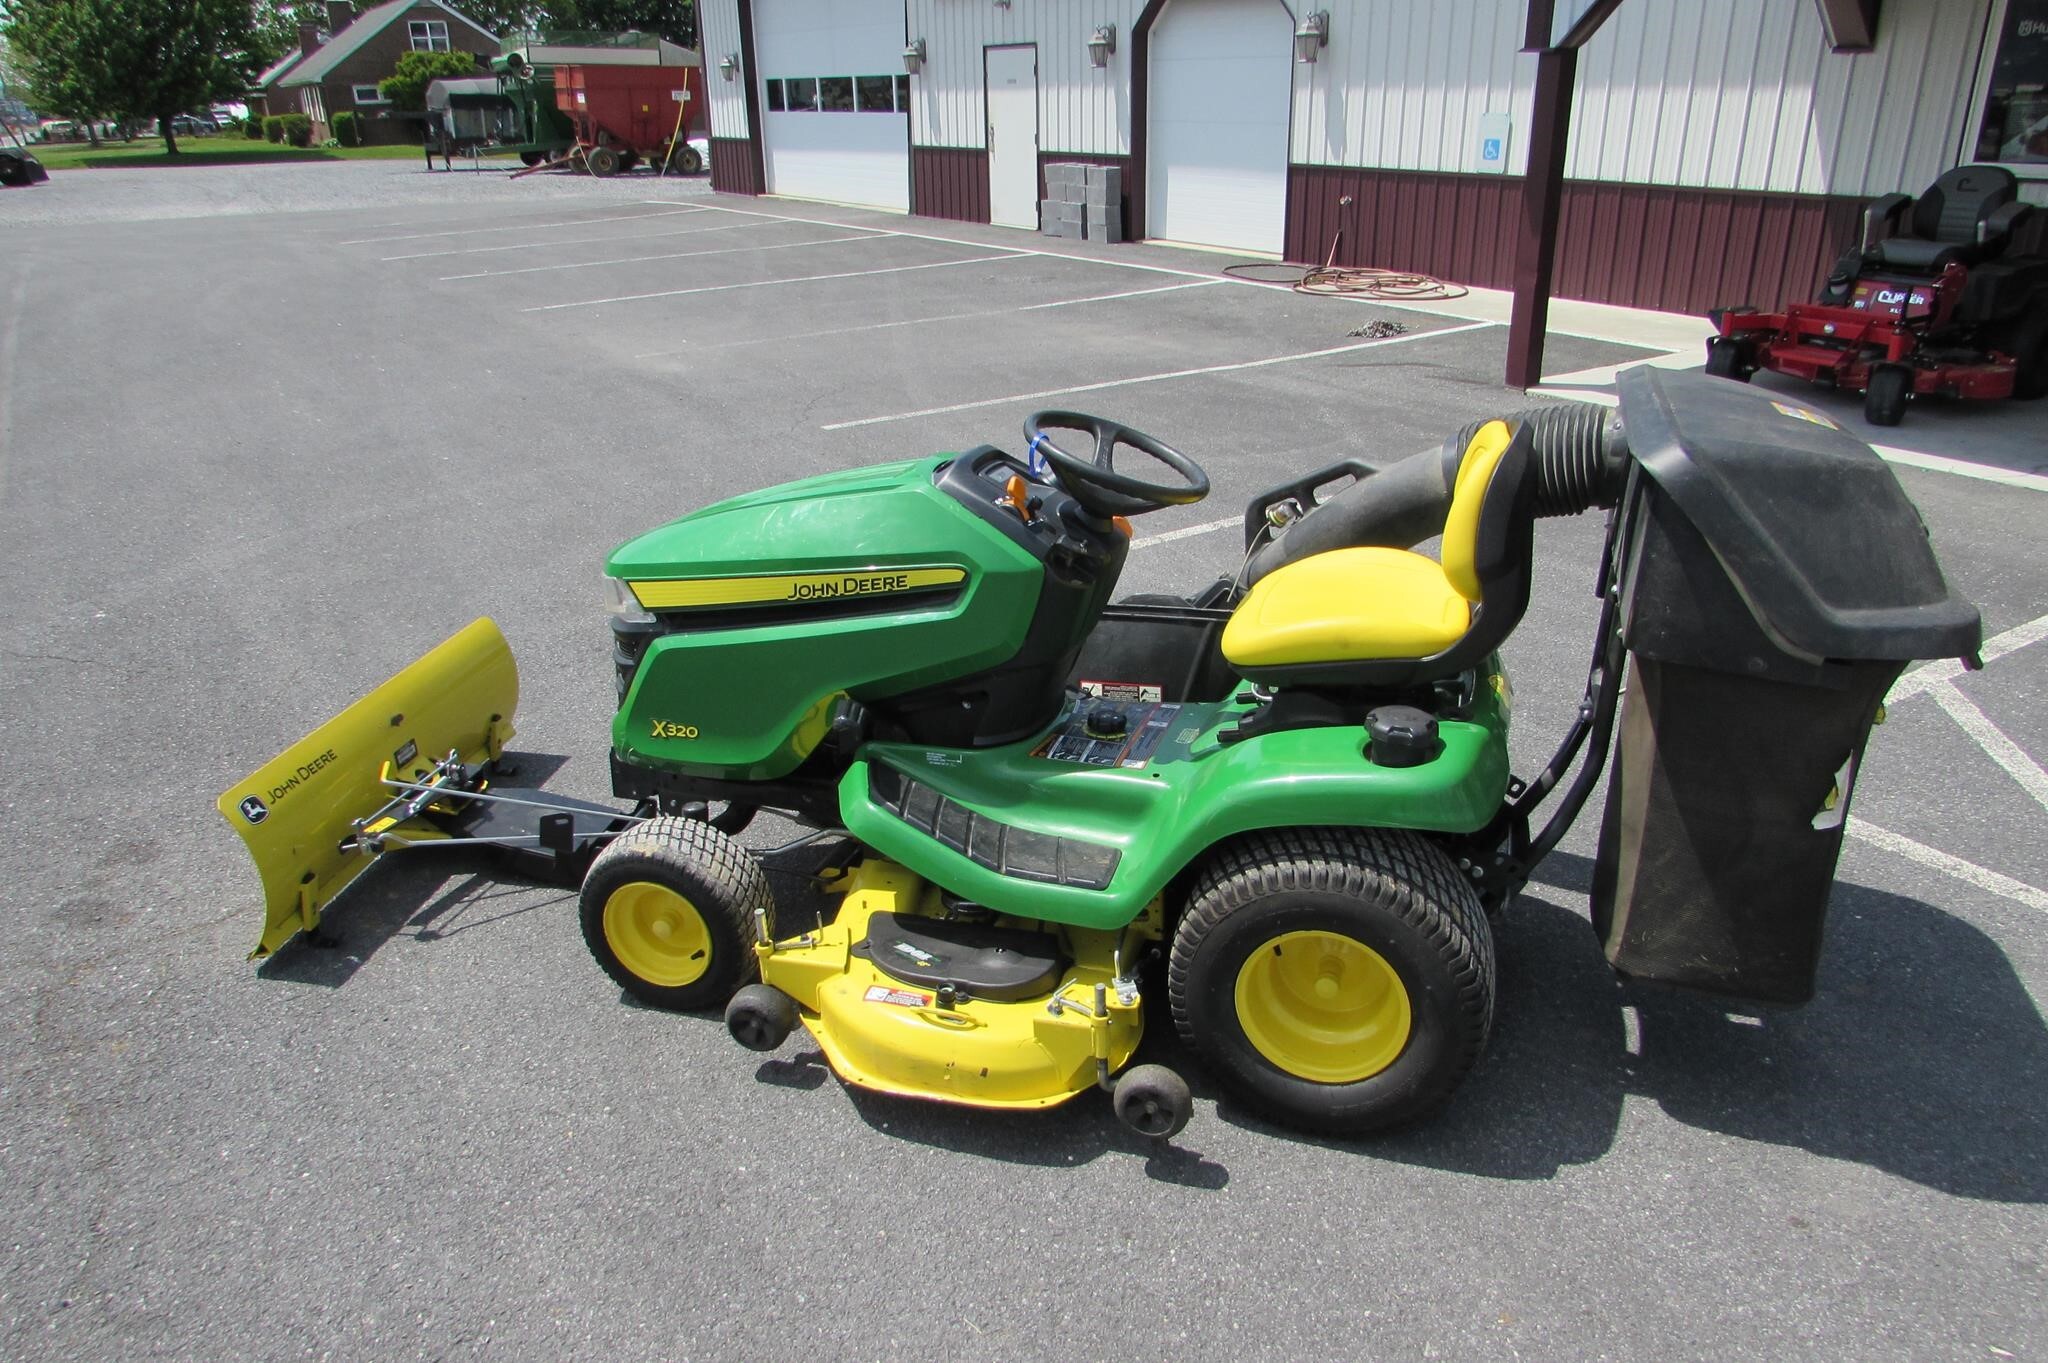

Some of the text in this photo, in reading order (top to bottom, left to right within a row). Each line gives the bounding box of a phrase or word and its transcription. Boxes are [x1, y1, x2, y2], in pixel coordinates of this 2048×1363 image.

[787, 575, 909, 600] JOHN DEERE
[651, 719, 699, 739] X320
[267, 749, 338, 805] JOHN DEERE
